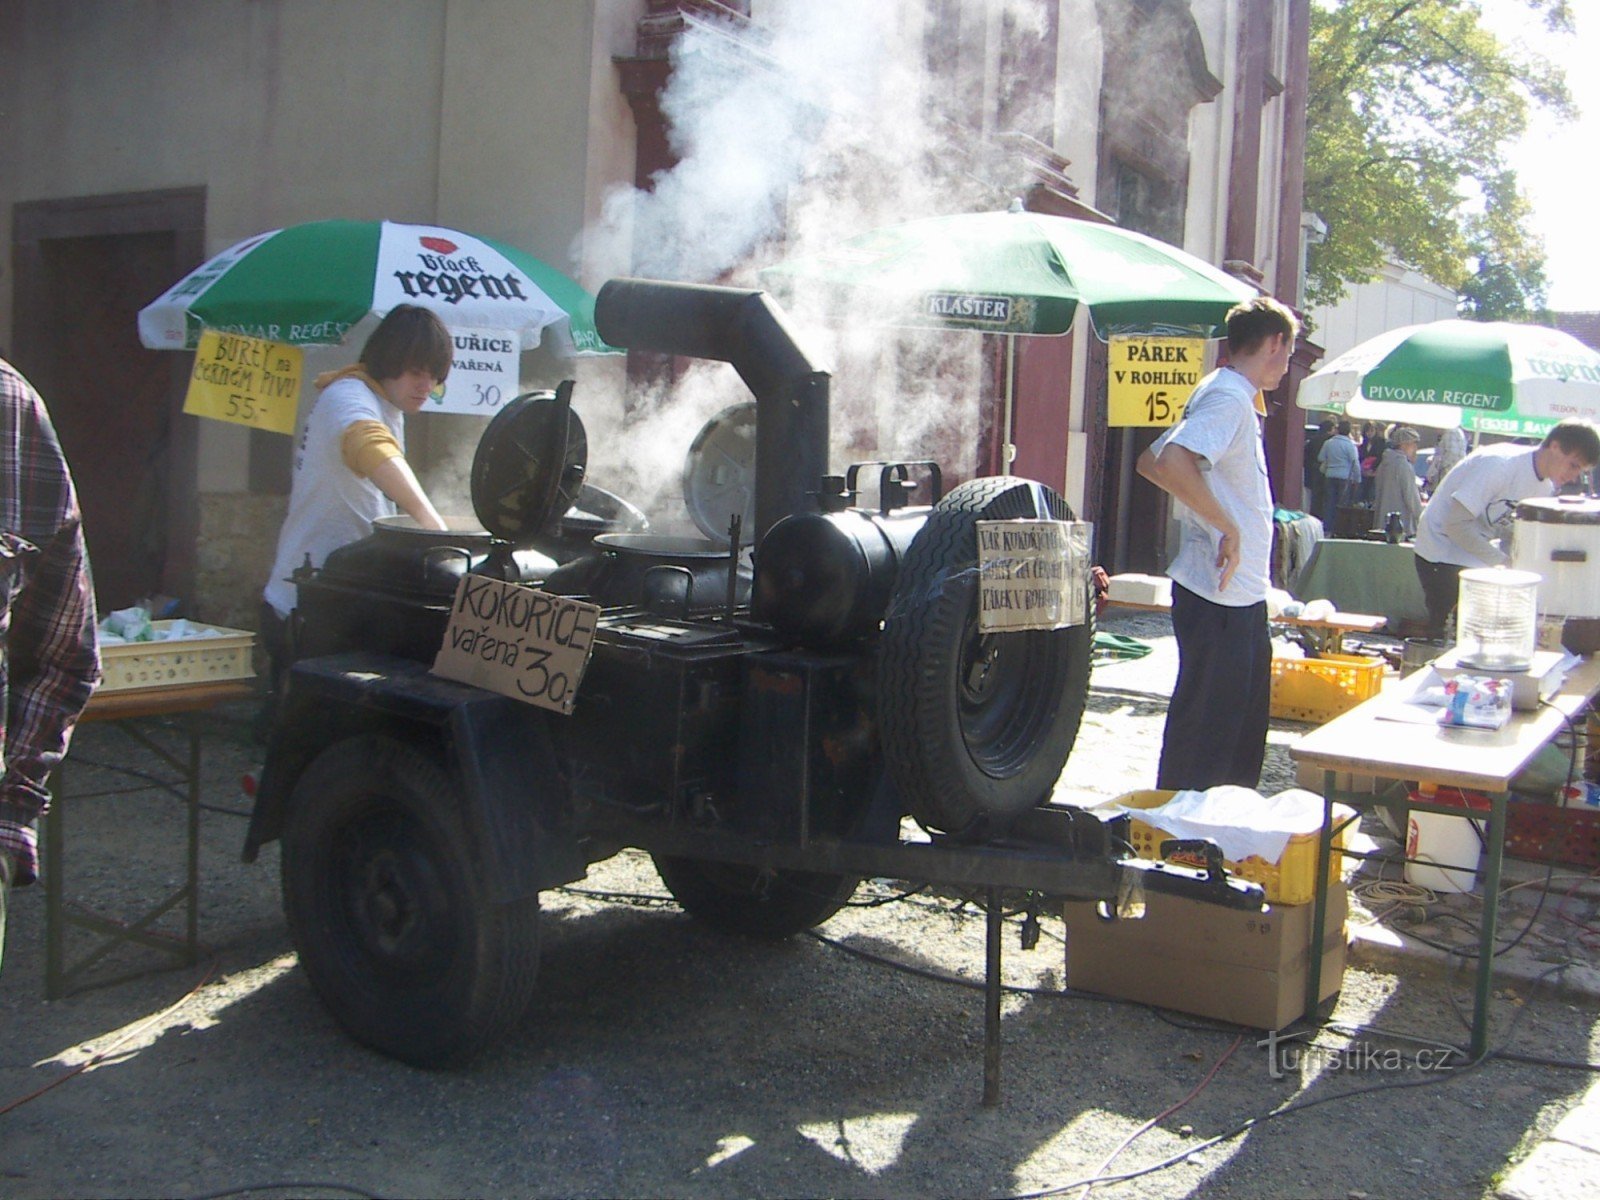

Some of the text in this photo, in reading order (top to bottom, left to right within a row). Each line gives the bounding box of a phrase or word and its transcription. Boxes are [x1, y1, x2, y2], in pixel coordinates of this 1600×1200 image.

[393, 270, 528, 305] regent
[1127, 340, 1188, 362] PÁREK
[1115, 368, 1198, 385] V ROHLÍKU
[1368, 386, 1436, 402] PIVOVAR
[1442, 392, 1500, 408] REGENT
